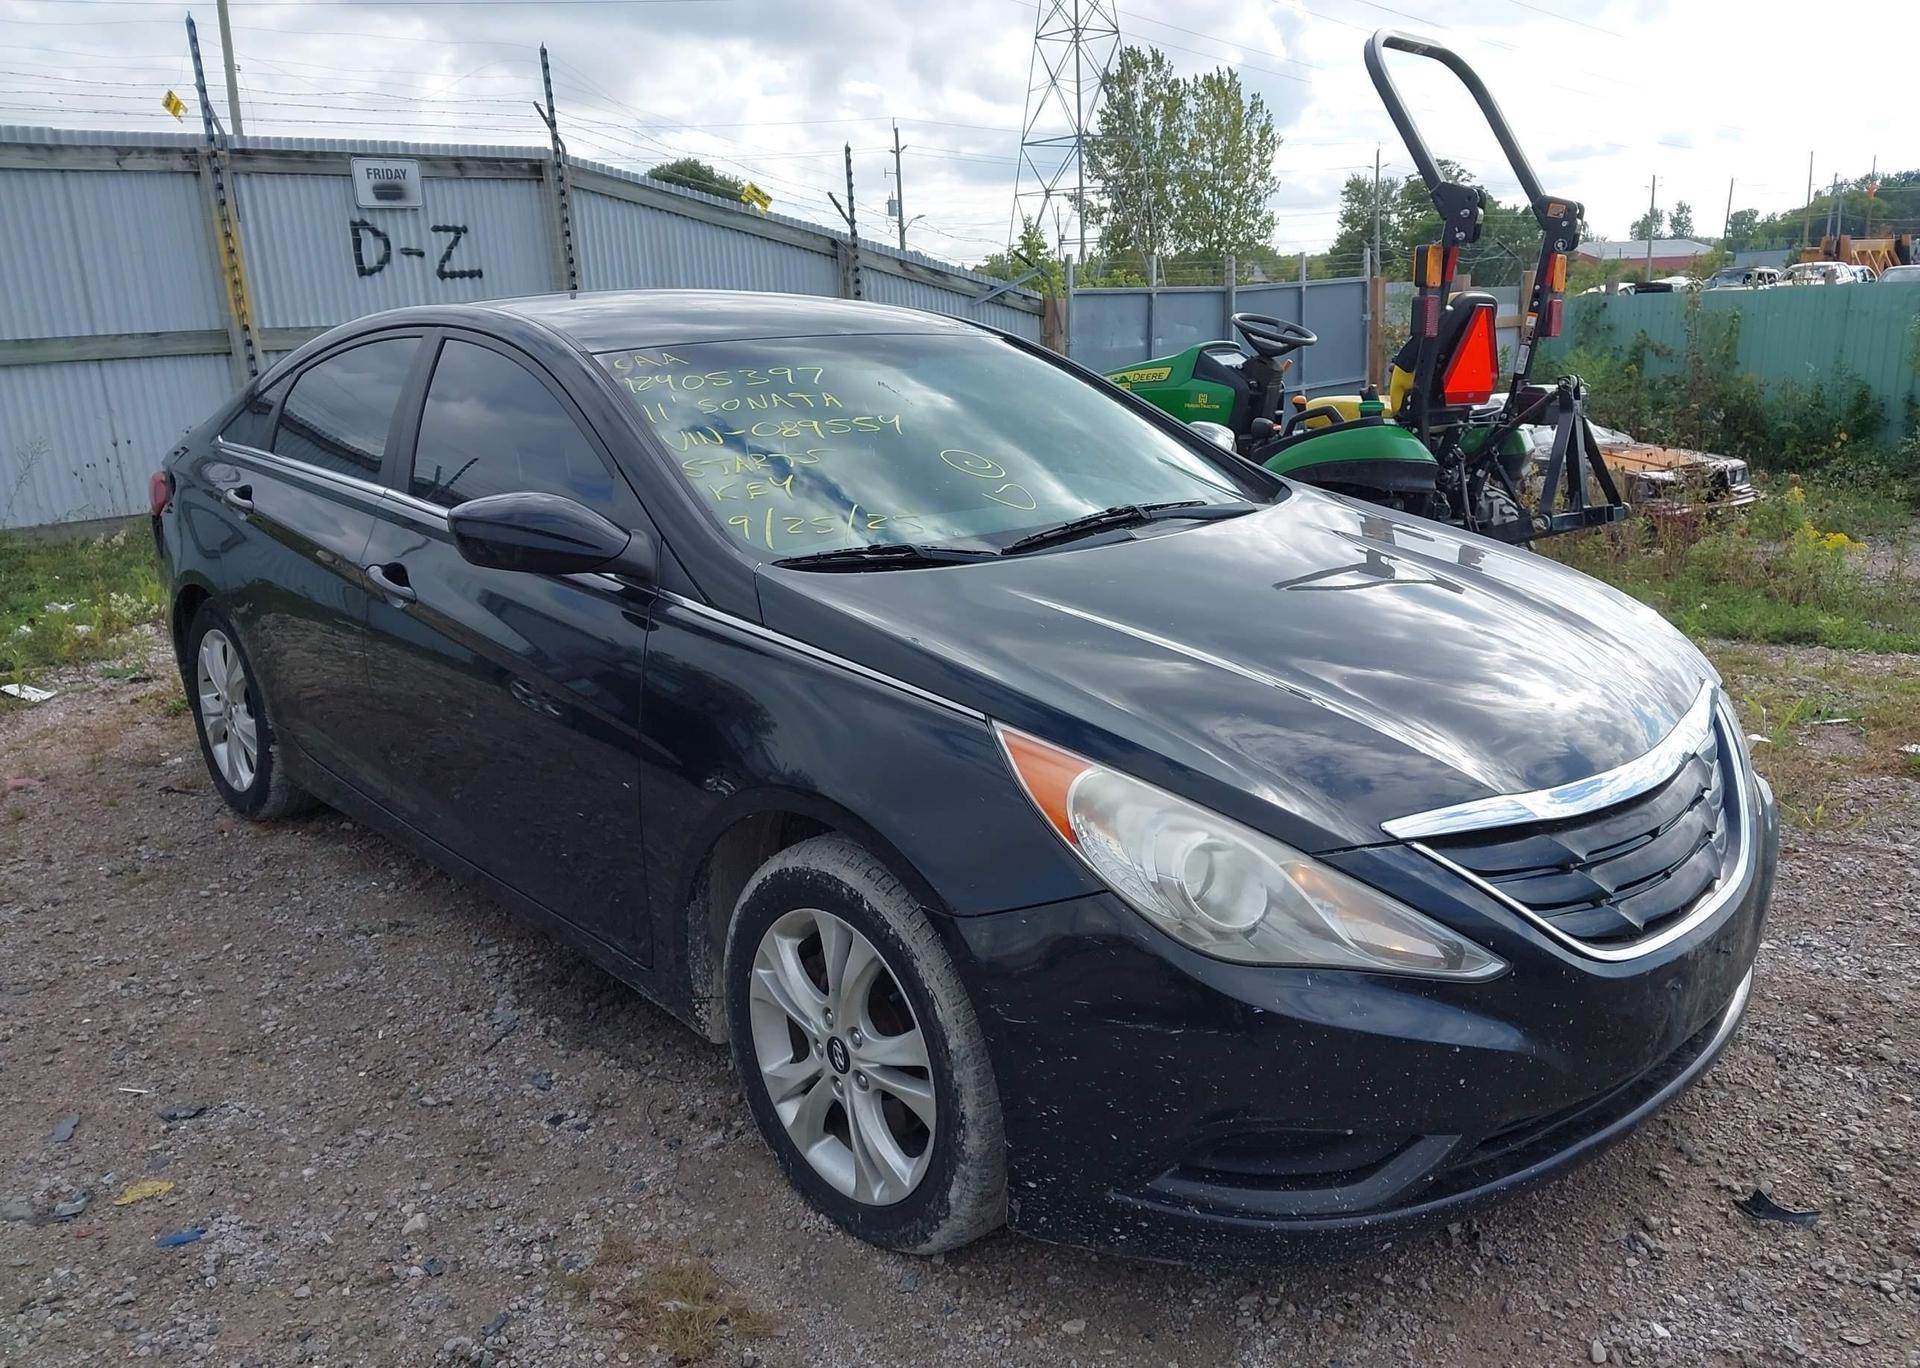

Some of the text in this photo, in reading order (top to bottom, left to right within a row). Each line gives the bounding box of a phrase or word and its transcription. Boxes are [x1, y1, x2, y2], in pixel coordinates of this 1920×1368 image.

[366, 167, 407, 180] FRIDAY
[1133, 372, 1165, 381] DEERE
[697, 392, 843, 415] SONATA
[708, 474, 794, 501] KEY
